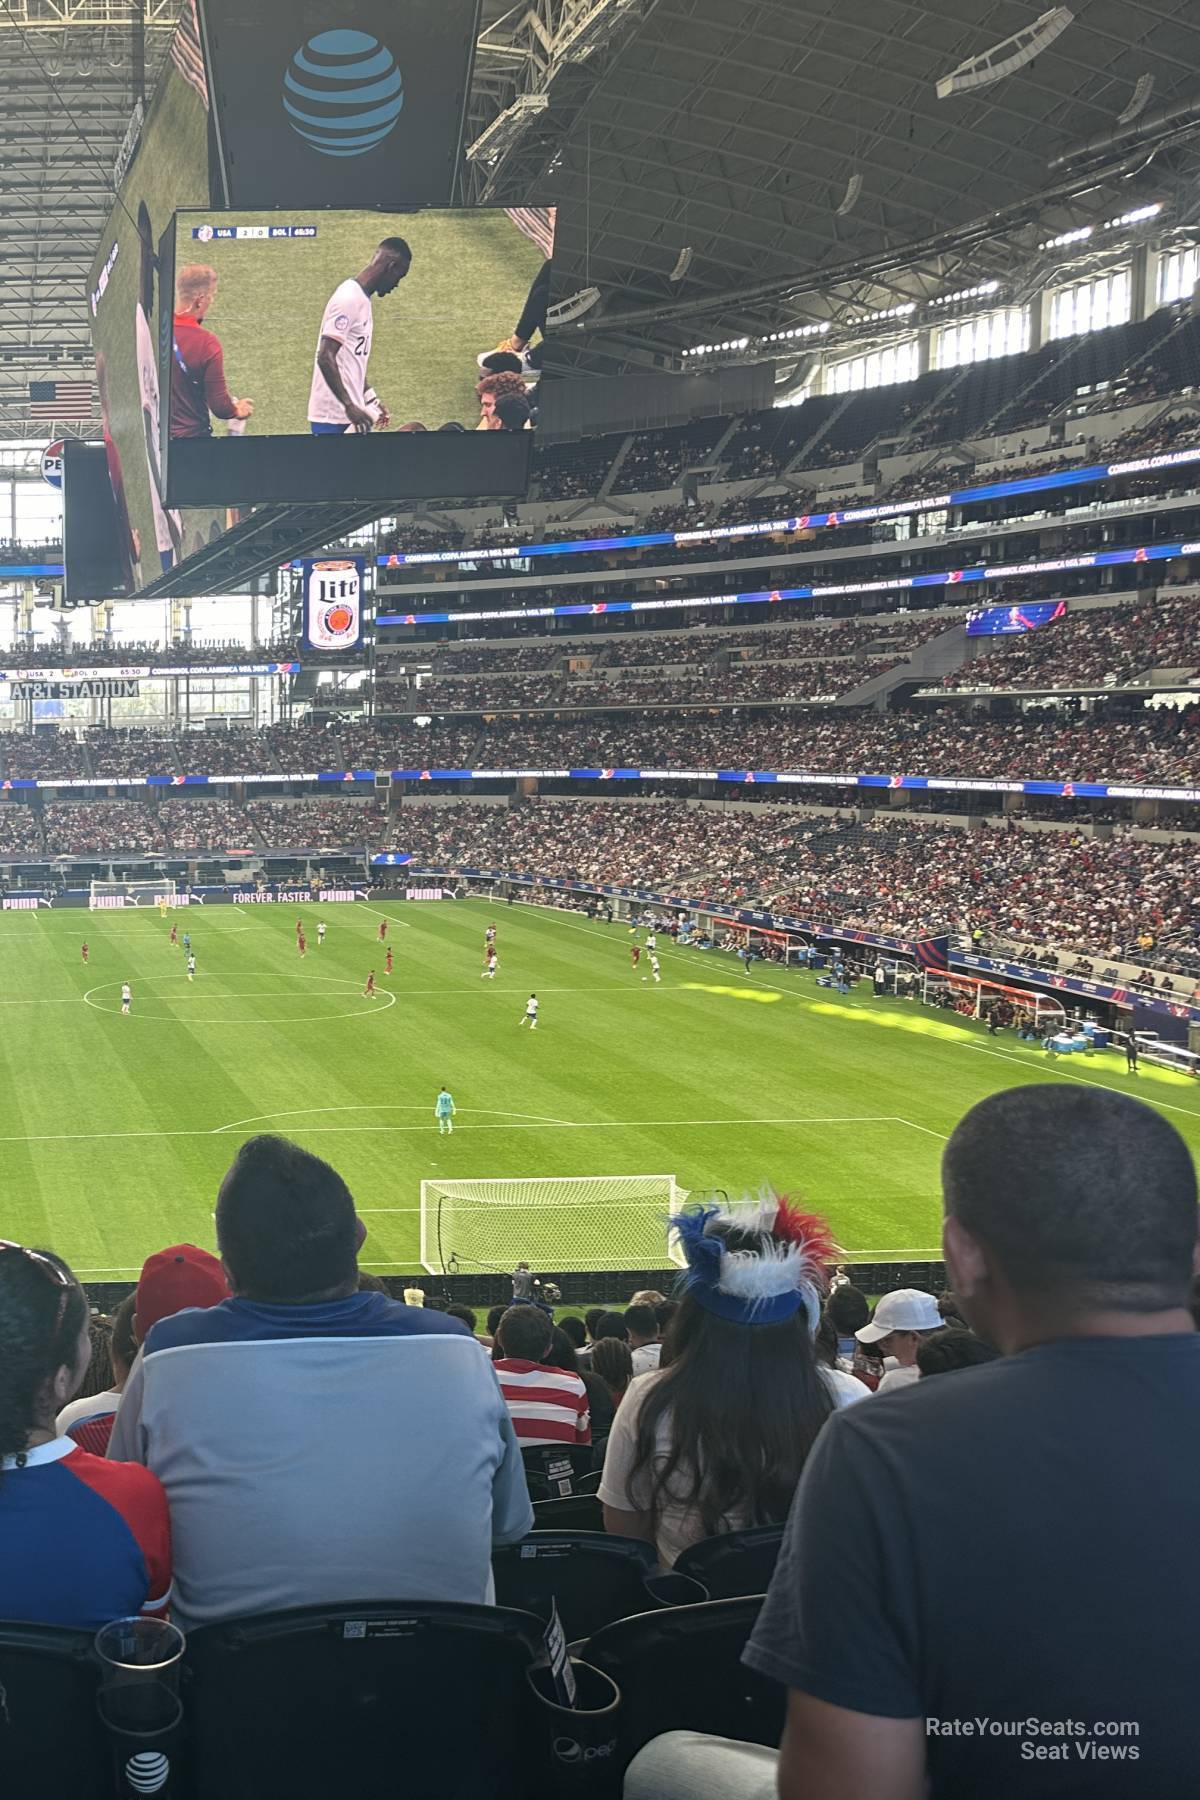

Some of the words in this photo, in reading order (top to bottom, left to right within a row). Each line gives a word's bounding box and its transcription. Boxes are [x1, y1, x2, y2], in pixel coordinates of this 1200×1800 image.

[44, 459, 61, 470] PE
[319, 580, 357, 603] Lite
[11, 682, 55, 699] AT&T
[60, 680, 139, 698] STADIUM
[233, 892, 276, 904] FOREVER.
[277, 892, 313, 903] FASTER.
[319, 890, 355, 901] PUMA
[406, 888, 442, 900] PUMA
[2, 898, 38, 909] PUMA
